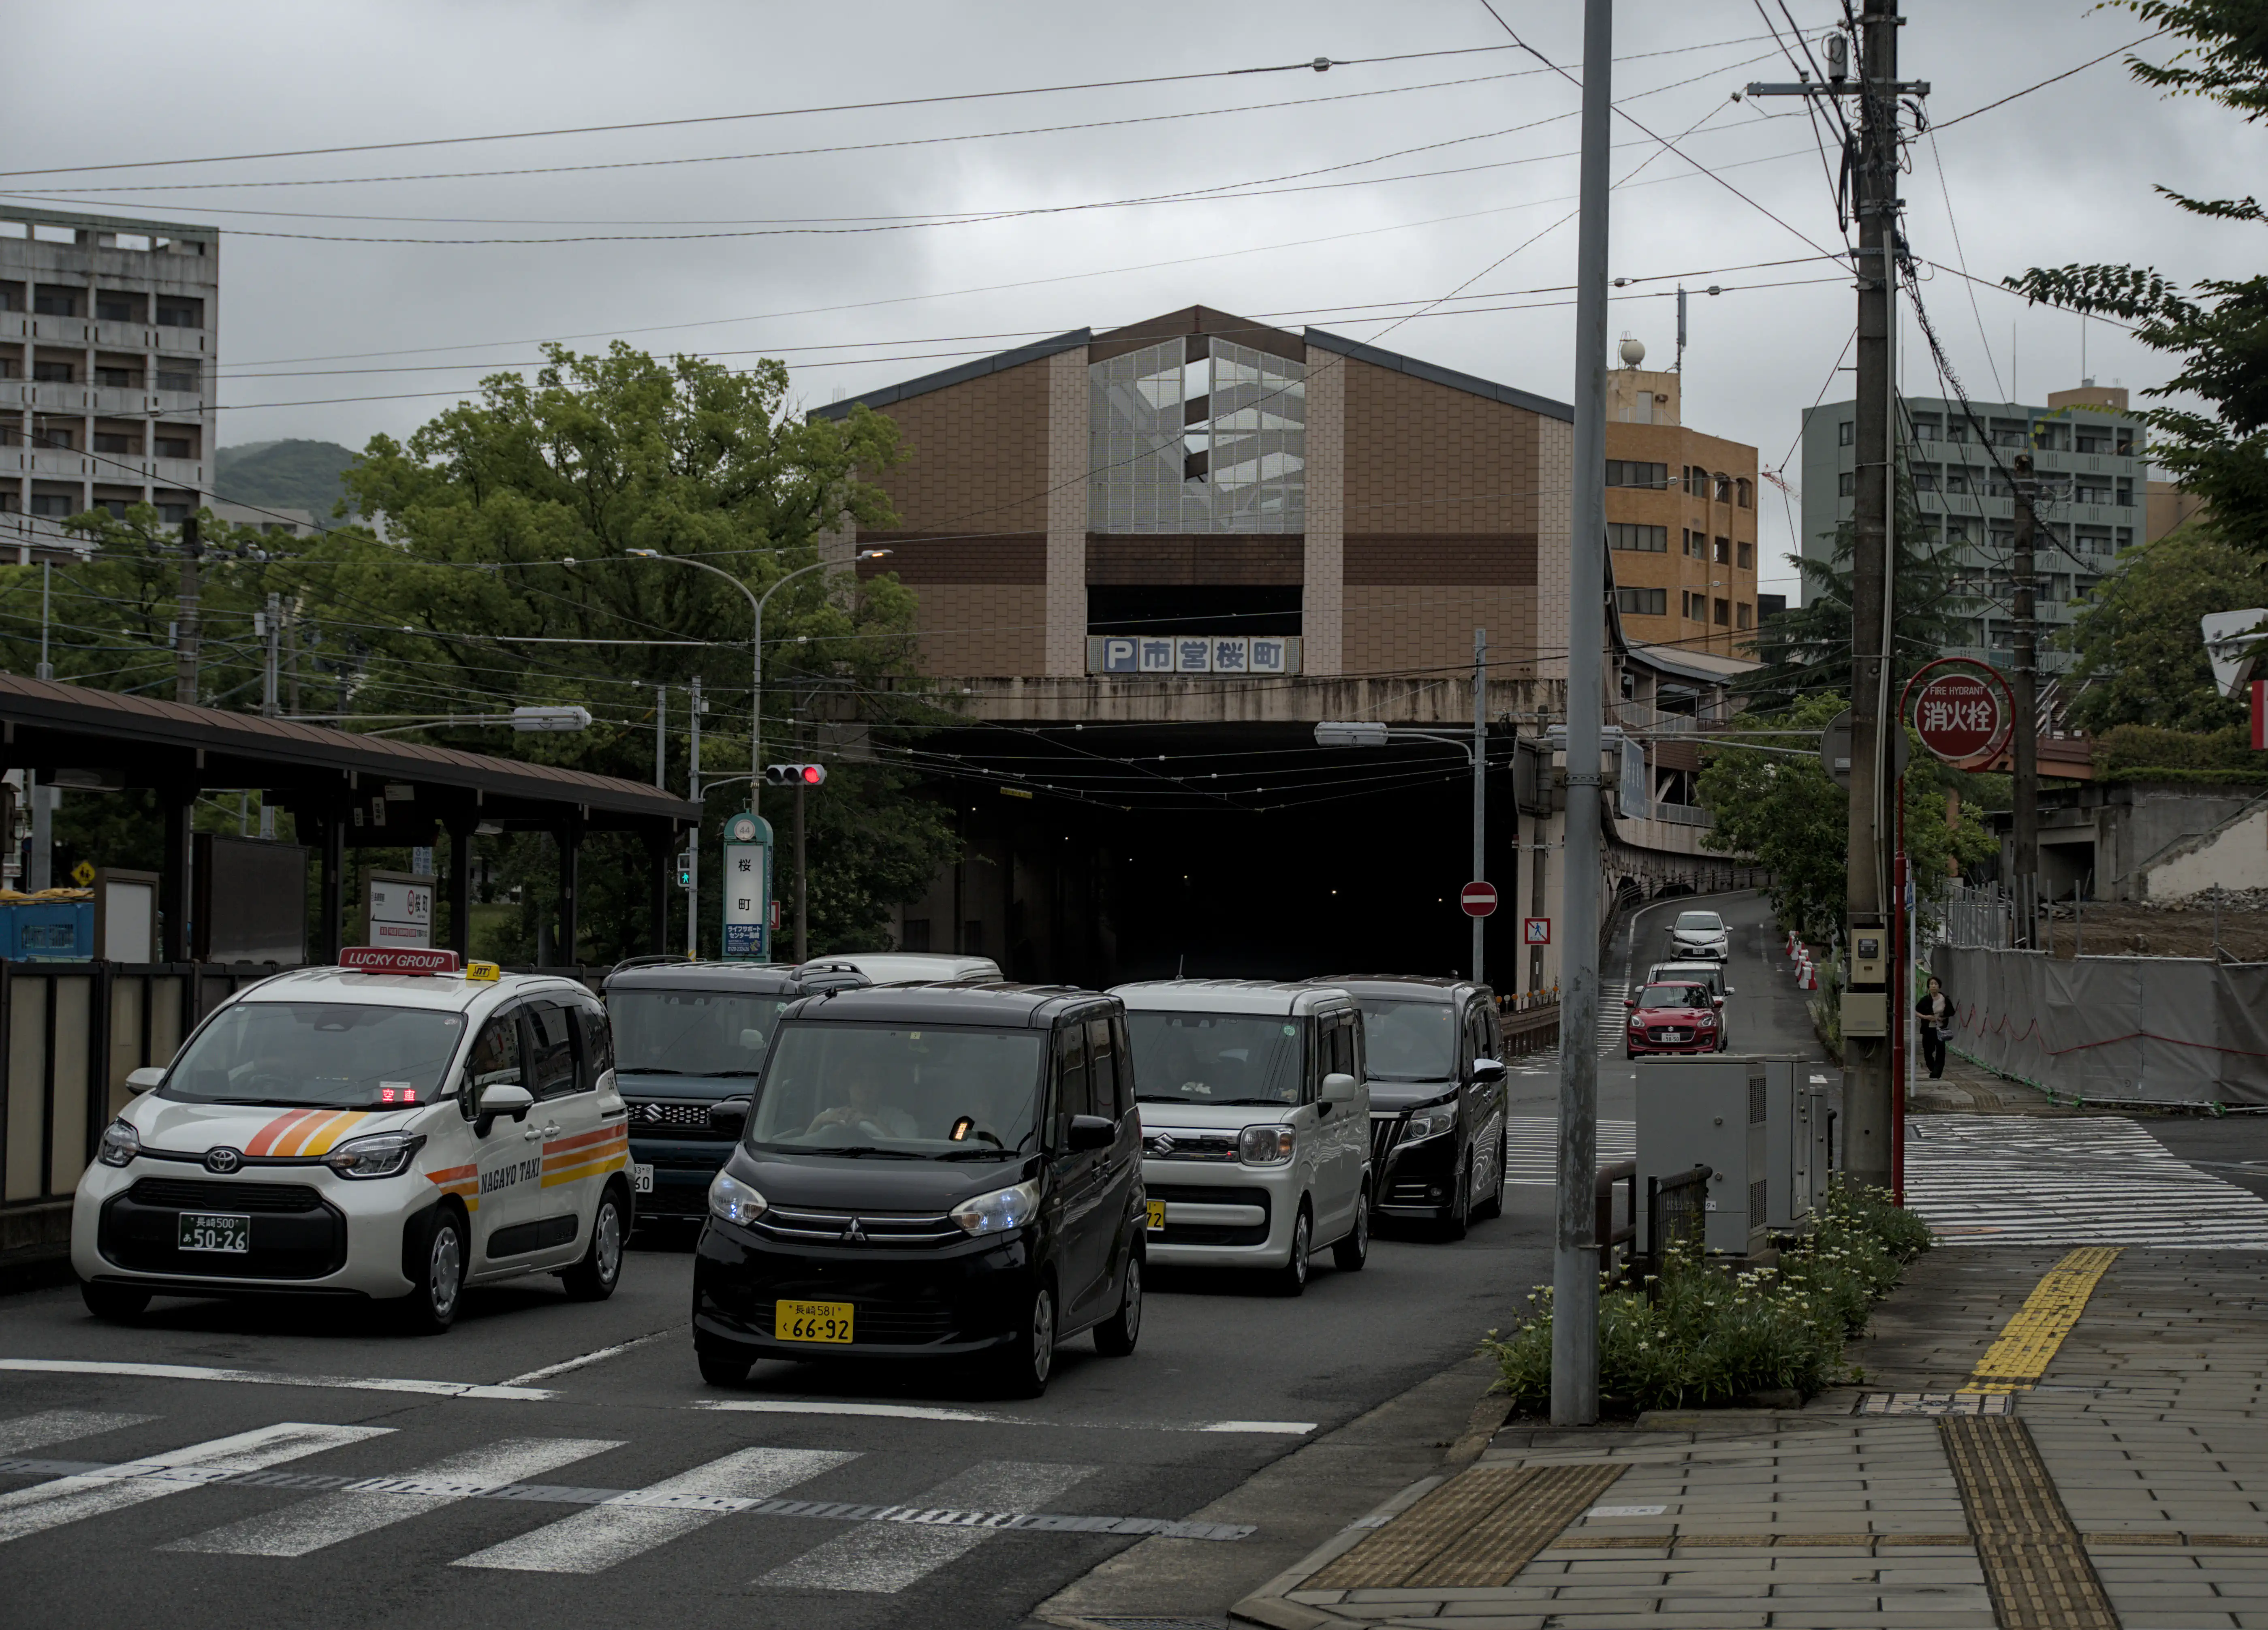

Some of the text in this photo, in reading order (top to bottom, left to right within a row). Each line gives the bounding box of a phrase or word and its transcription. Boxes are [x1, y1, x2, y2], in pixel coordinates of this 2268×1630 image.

[1143, 641, 1282, 669] 市営桜町
[1930, 686, 1984, 695] FIRE HYDRANT
[1924, 700, 1992, 731] 消火栓
[739, 859, 752, 911] 桜町
[348, 953, 444, 968] LUCKY GROUP
[481, 1157, 540, 1195] NAGAYO TAXI
[183, 1229, 246, 1250] あ 50-26
[793, 1318, 848, 1339] 66-92
